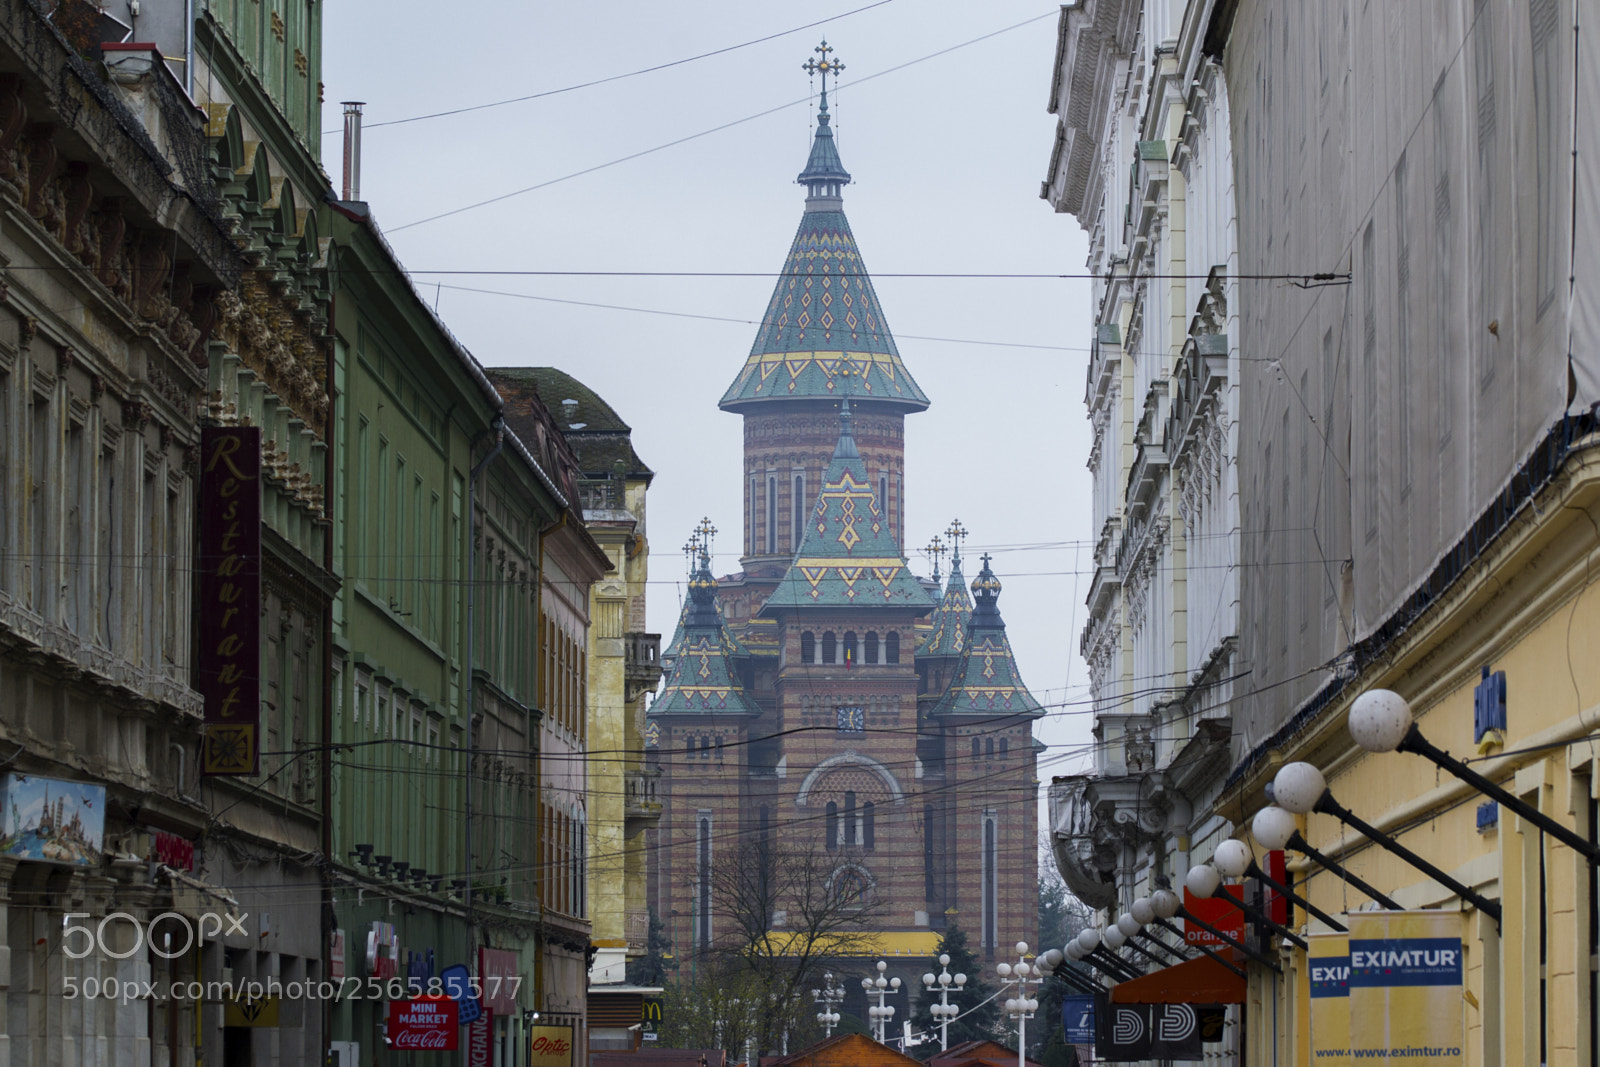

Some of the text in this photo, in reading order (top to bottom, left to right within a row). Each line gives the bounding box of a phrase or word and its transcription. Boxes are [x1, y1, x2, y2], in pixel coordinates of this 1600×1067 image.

[206, 435, 257, 718] Restaurant
[1352, 950, 1456, 968] EXIMTUR
[411, 1003, 437, 1013] MINI
[398, 1014, 448, 1024] MARKET
[532, 1037, 571, 1056] Optic
[1353, 1045, 1461, 1058] www.eximtur.ro
